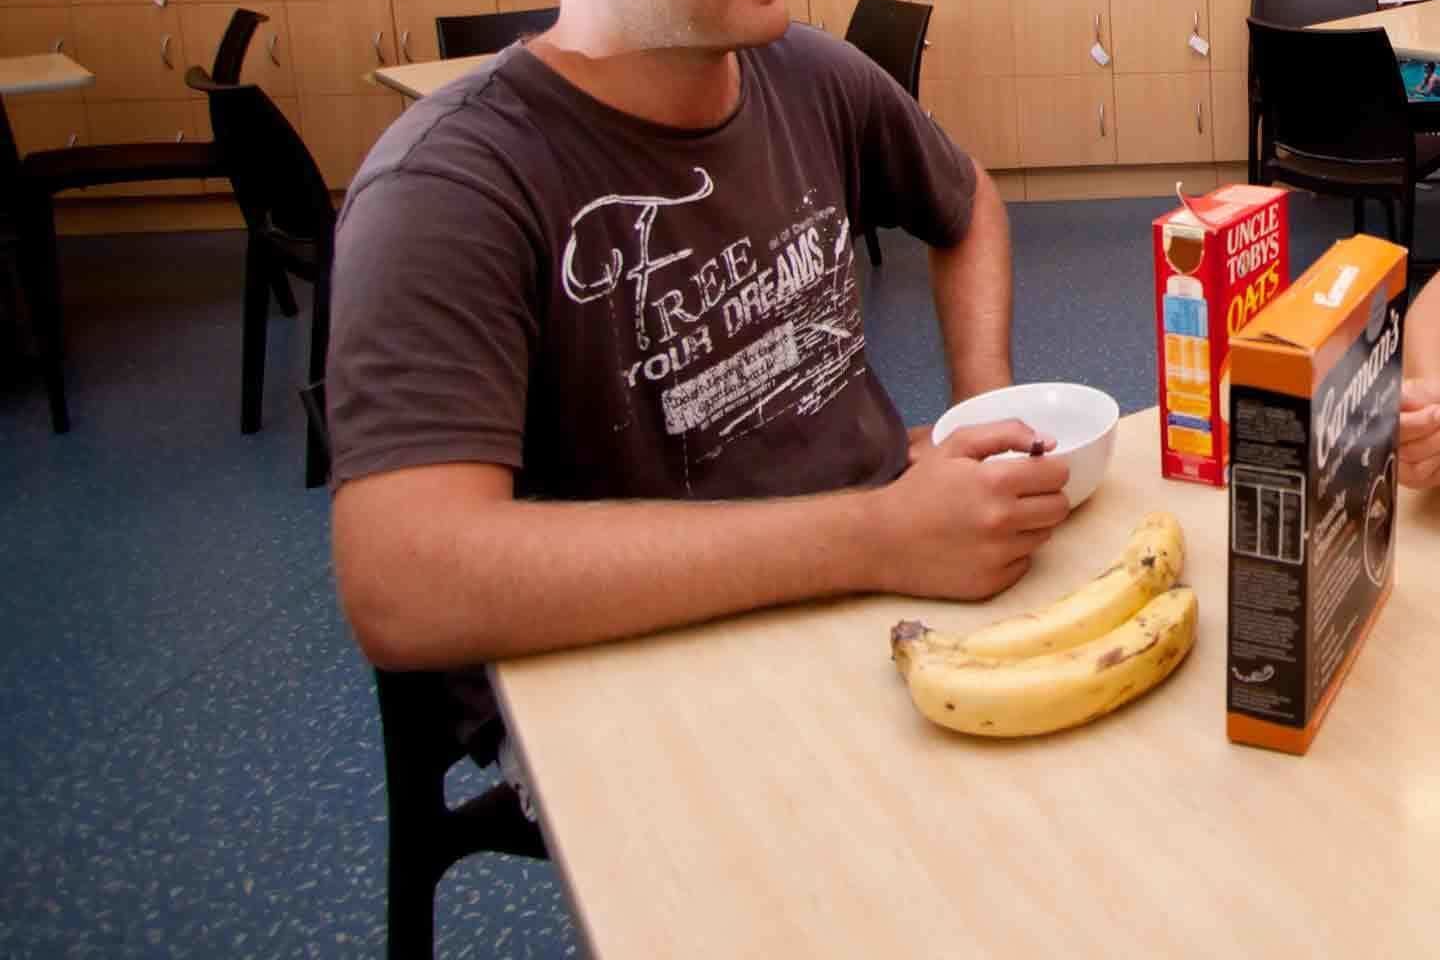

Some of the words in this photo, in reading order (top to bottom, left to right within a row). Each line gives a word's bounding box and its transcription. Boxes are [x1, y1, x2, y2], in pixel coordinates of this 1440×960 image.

[1226, 202, 1280, 256] UNCLE
[1226, 230, 1280, 287] TOBYS
[624, 325, 713, 387] YOUR
[721, 226, 827, 338] DREAMS
[1227, 258, 1281, 337] OATS
[1316, 307, 1400, 470] Carman's
